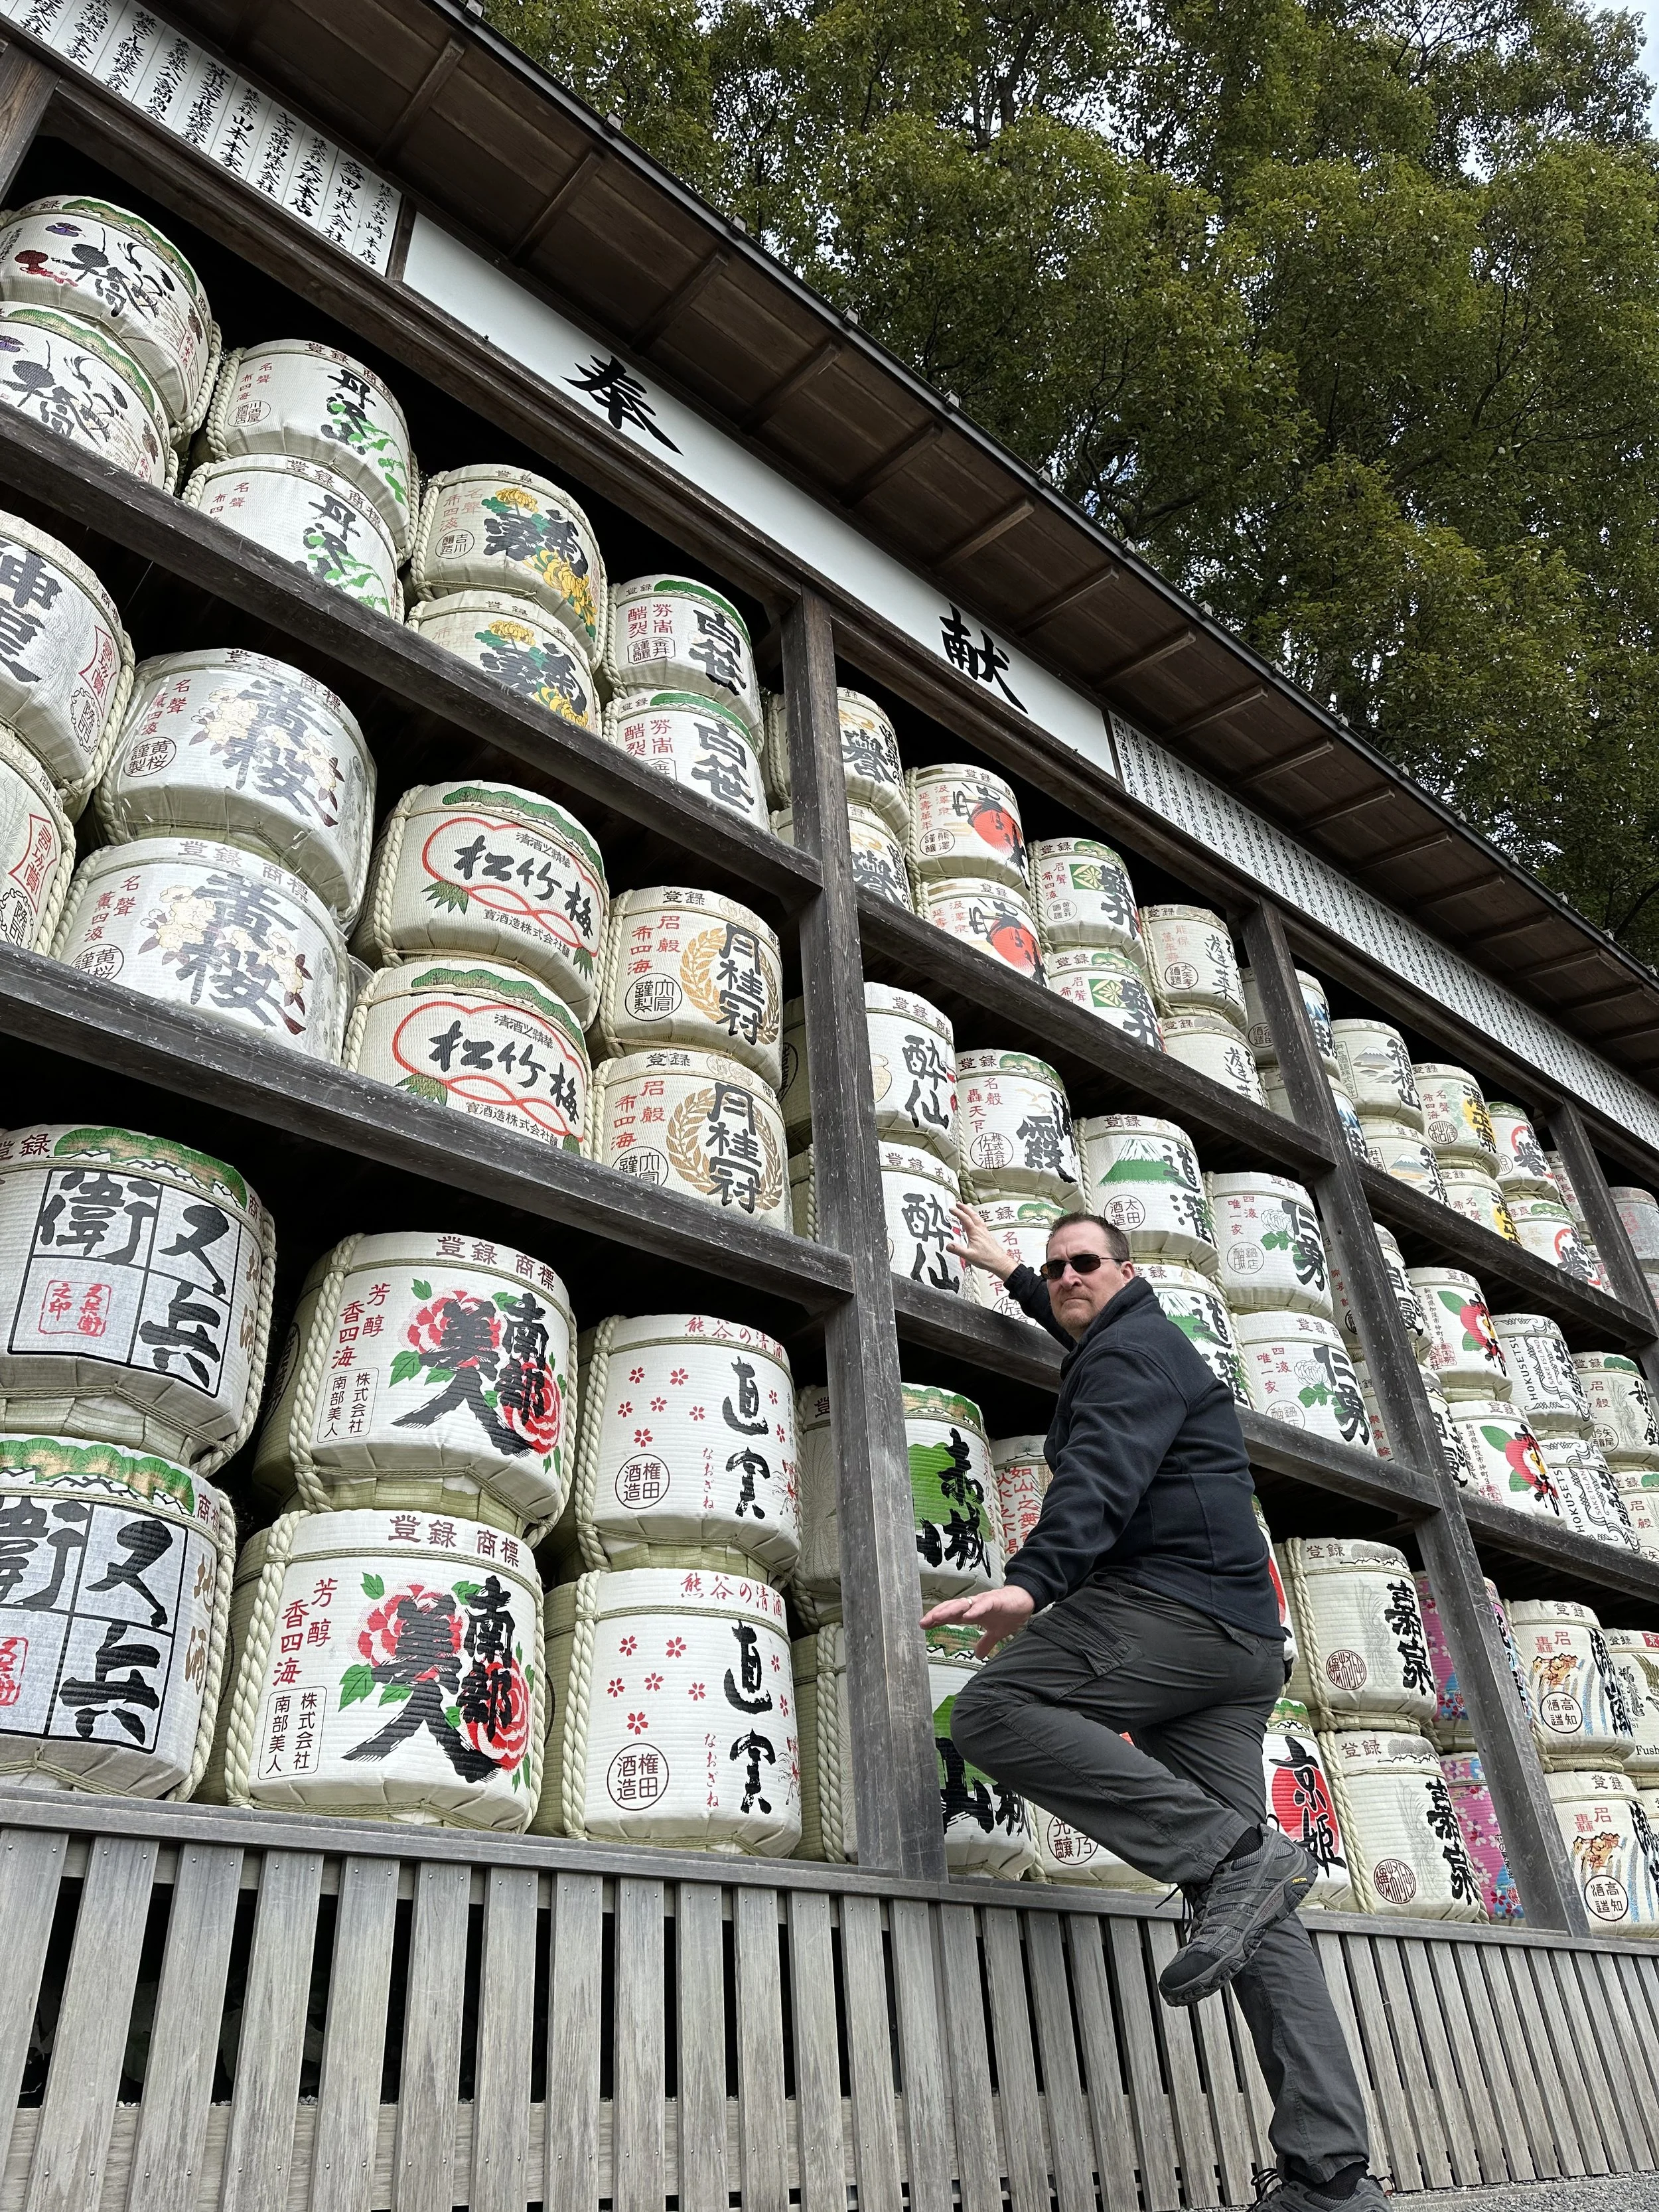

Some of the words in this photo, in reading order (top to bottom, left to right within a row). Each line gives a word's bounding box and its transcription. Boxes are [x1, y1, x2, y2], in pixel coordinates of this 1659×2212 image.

[325, 160, 365, 248] 盛田株式会社
[306, 342, 348, 364] 登録
[248, 402, 262, 423] 川西屋
[559, 354, 684, 457] 奉
[286, 459, 335, 488] 登録
[453, 534, 467, 552] 吉川
[653, 638, 669, 657] 金井
[938, 601, 1029, 715] 献
[127, 745, 149, 775] 謹製
[147, 740, 171, 768] 黄桜
[1040, 842, 1070, 855] 登録
[178, 840, 242, 867] 登録
[263, 861, 313, 904] 商標
[454, 835, 593, 938] 松竹梅
[663, 890, 705, 906] 登録
[1148, 907, 1175, 919] 登録
[1055, 954, 1089, 969] 登録
[634, 981, 654, 1013] 謹製
[717, 922, 766, 1047] 月桂冠
[893, 995, 928, 1023] 登録
[1163, 1019, 1194, 1031] 登録
[429, 1019, 579, 1126] 松竹梅
[646, 1053, 691, 1068] 登録
[958, 1055, 997, 1071] 登録
[901, 1035, 950, 1130] 酔仙
[1104, 1115, 1142, 1129] 登録
[705, 1082, 762, 1215] 月桂冠
[885, 1152, 925, 1173] 登録
[977, 1135, 993, 1169] 佐浦
[989, 1132, 1006, 1169] 株式会社
[1110, 1201, 1125, 1226] 酒造
[1124, 1199, 1140, 1224] 太田
[901, 1192, 960, 1294] 酔仙
[436, 1236, 498, 1265] 登録
[515, 1253, 555, 1291] 商標
[362, 1283, 391, 1337] 芳醇
[331, 1299, 366, 1370] 香四海
[684, 1315, 784, 1361] 熊谷の清酒
[324, 1376, 347, 1439] 南部美人
[348, 1372, 370, 1434] 株式会社
[622, 1462, 642, 1503] 酒造
[642, 1461, 662, 1500] 権田
[703, 1447, 715, 1511] なおざね
[1553, 1469, 1585, 1534] HOKUSETS
[388, 1514, 457, 1548] 登録
[476, 1529, 521, 1568] 商標
[1307, 1544, 1346, 1560] 登録
[307, 1578, 338, 1647] 芳醇
[680, 1572, 784, 1618] 熊谷の清酒
[272, 1599, 309, 1686] 香四海
[293, 1693, 318, 1770] 株式会社
[1546, 1699, 1564, 1726] 酒造
[1559, 1698, 1578, 1726] 高知
[265, 1696, 291, 1775] 南部美人
[1340, 1739, 1382, 1759] 登録
[616, 1754, 637, 1803] 酒造
[638, 1753, 659, 1798] 権田
[704, 1733, 719, 1808] なおざね
[1590, 1883, 1611, 1914] 酒造
[1605, 1881, 1624, 1912] 高知
